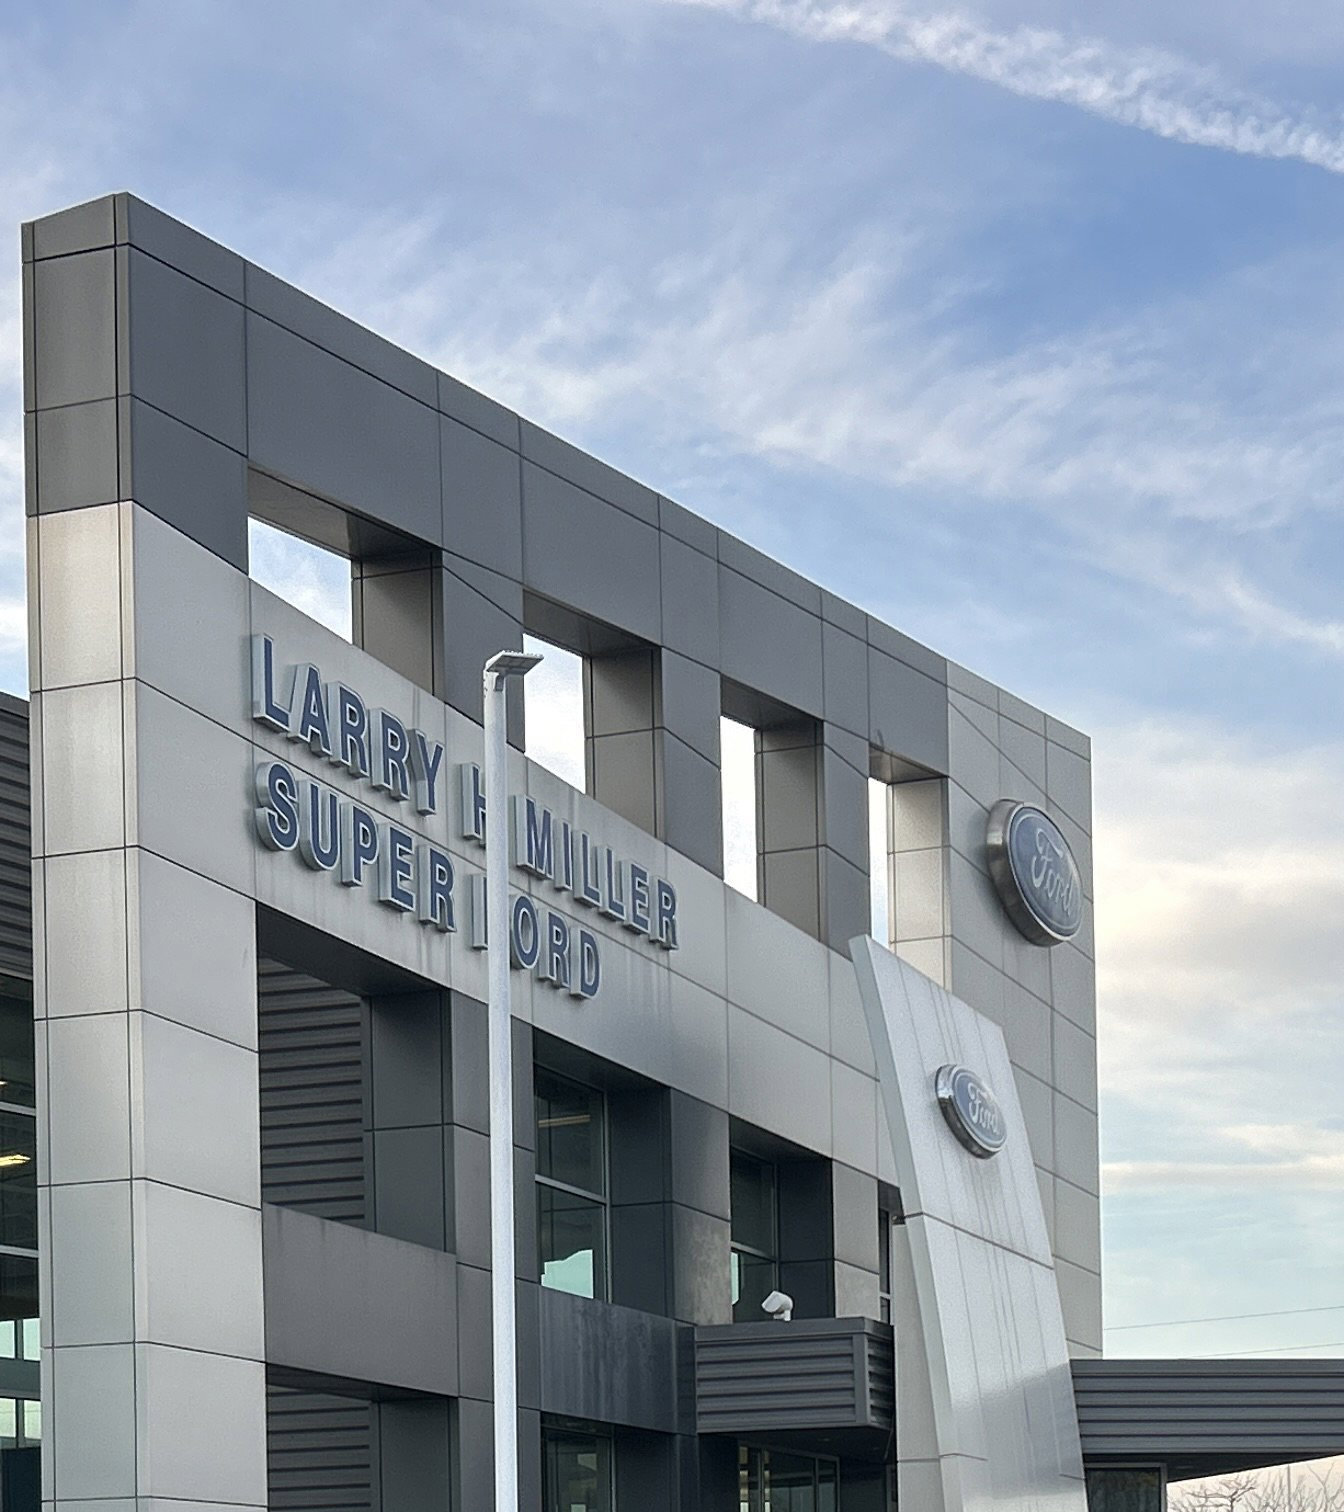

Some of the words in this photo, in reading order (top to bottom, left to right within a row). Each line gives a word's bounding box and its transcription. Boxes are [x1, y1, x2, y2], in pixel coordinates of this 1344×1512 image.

[253, 633, 443, 816] LARRY
[514, 795, 678, 949] MILLER
[256, 761, 456, 932] SUPER
[471, 872, 601, 999] ORD
